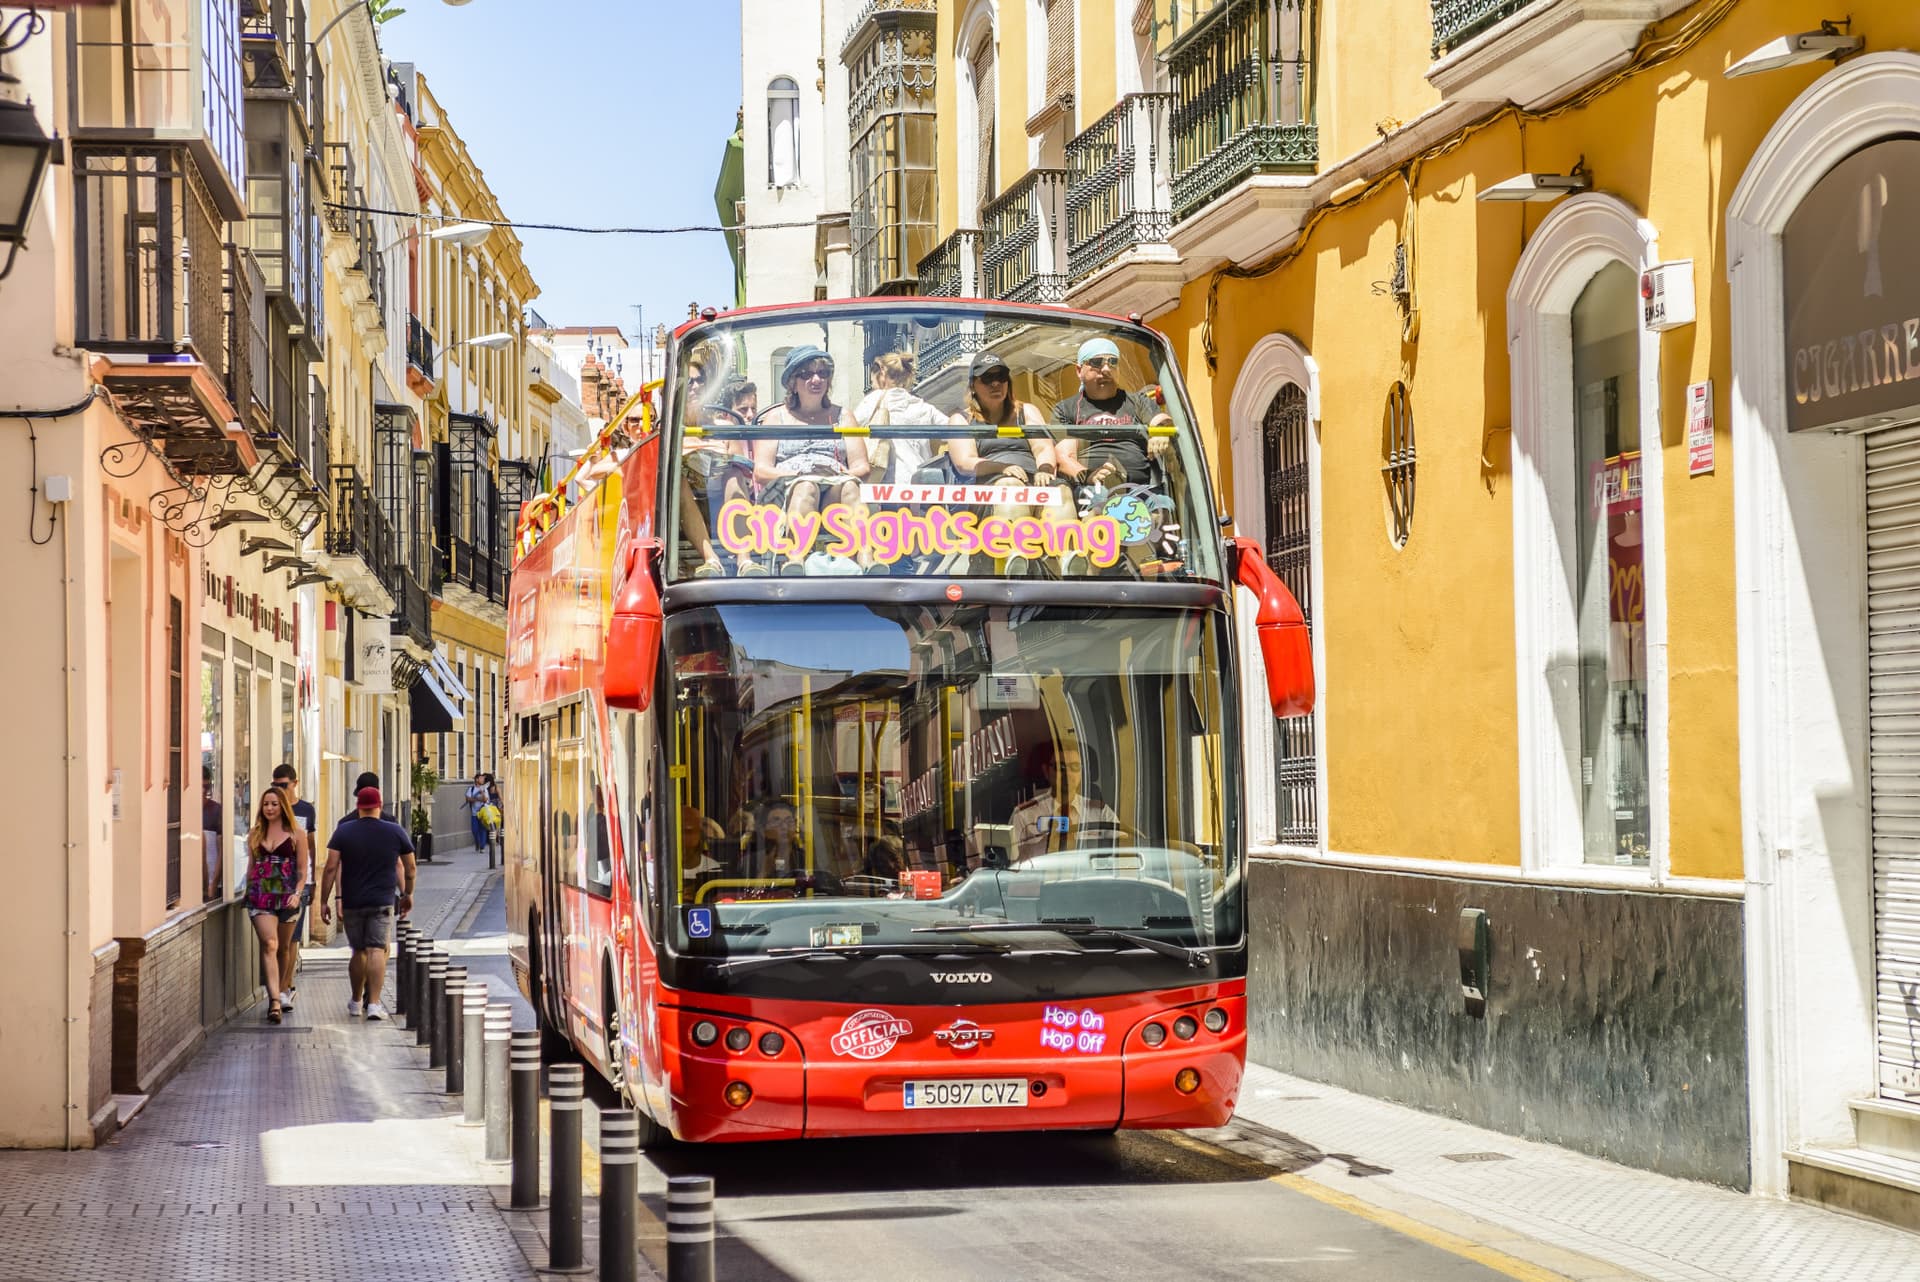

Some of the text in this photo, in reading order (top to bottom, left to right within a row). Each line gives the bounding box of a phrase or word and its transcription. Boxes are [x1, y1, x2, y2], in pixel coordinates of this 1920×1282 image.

[1690, 417, 1713, 433] ALARMA
[872, 485, 1050, 503] Worldwide
[718, 499, 1121, 567] City Sightseeing
[930, 972, 993, 984] VOLVO
[1044, 1006, 1104, 1030] Hop On
[839, 1022, 908, 1050] OFFICIAL
[1041, 1028, 1107, 1053] Hop Off
[861, 1039, 893, 1057] TOUR
[924, 1083, 1019, 1105] 5097 CVZ
